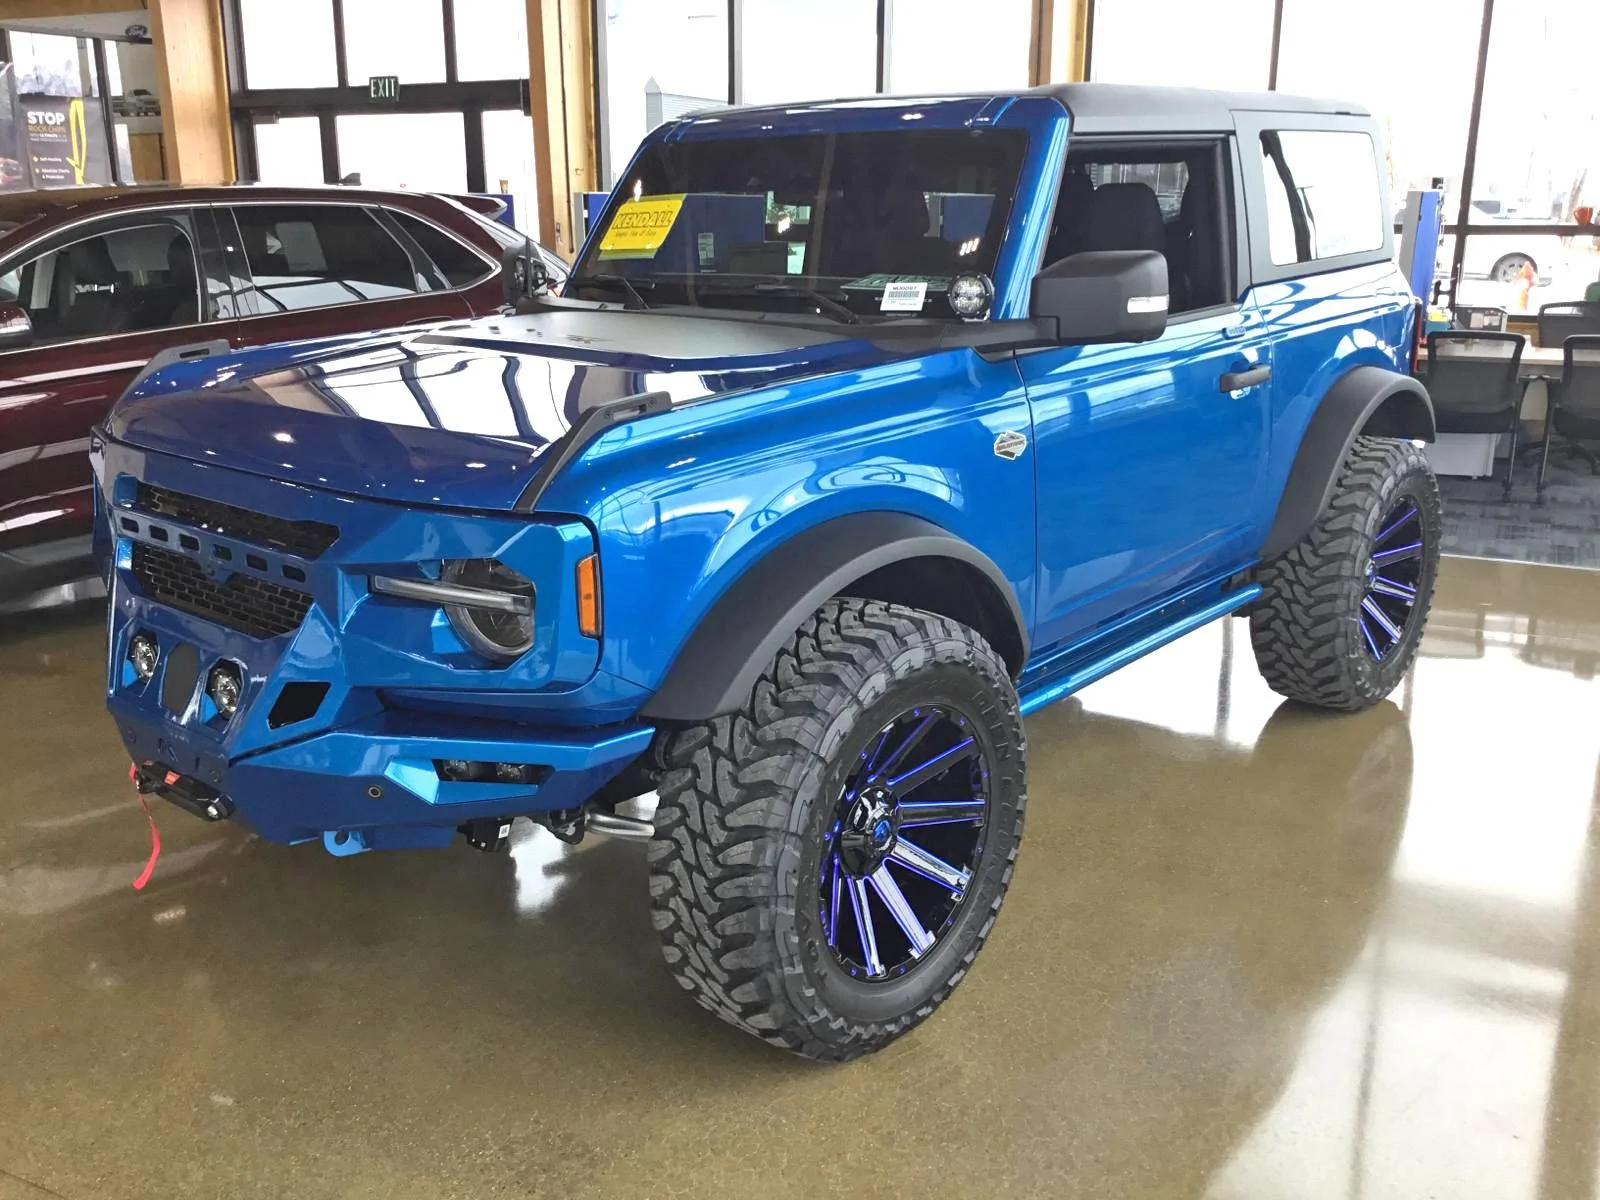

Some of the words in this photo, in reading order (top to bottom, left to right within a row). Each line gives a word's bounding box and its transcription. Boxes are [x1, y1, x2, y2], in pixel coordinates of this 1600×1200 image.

[371, 78, 396, 98] EXIT
[27, 111, 65, 125] STOP
[611, 210, 674, 230] KENDALL
